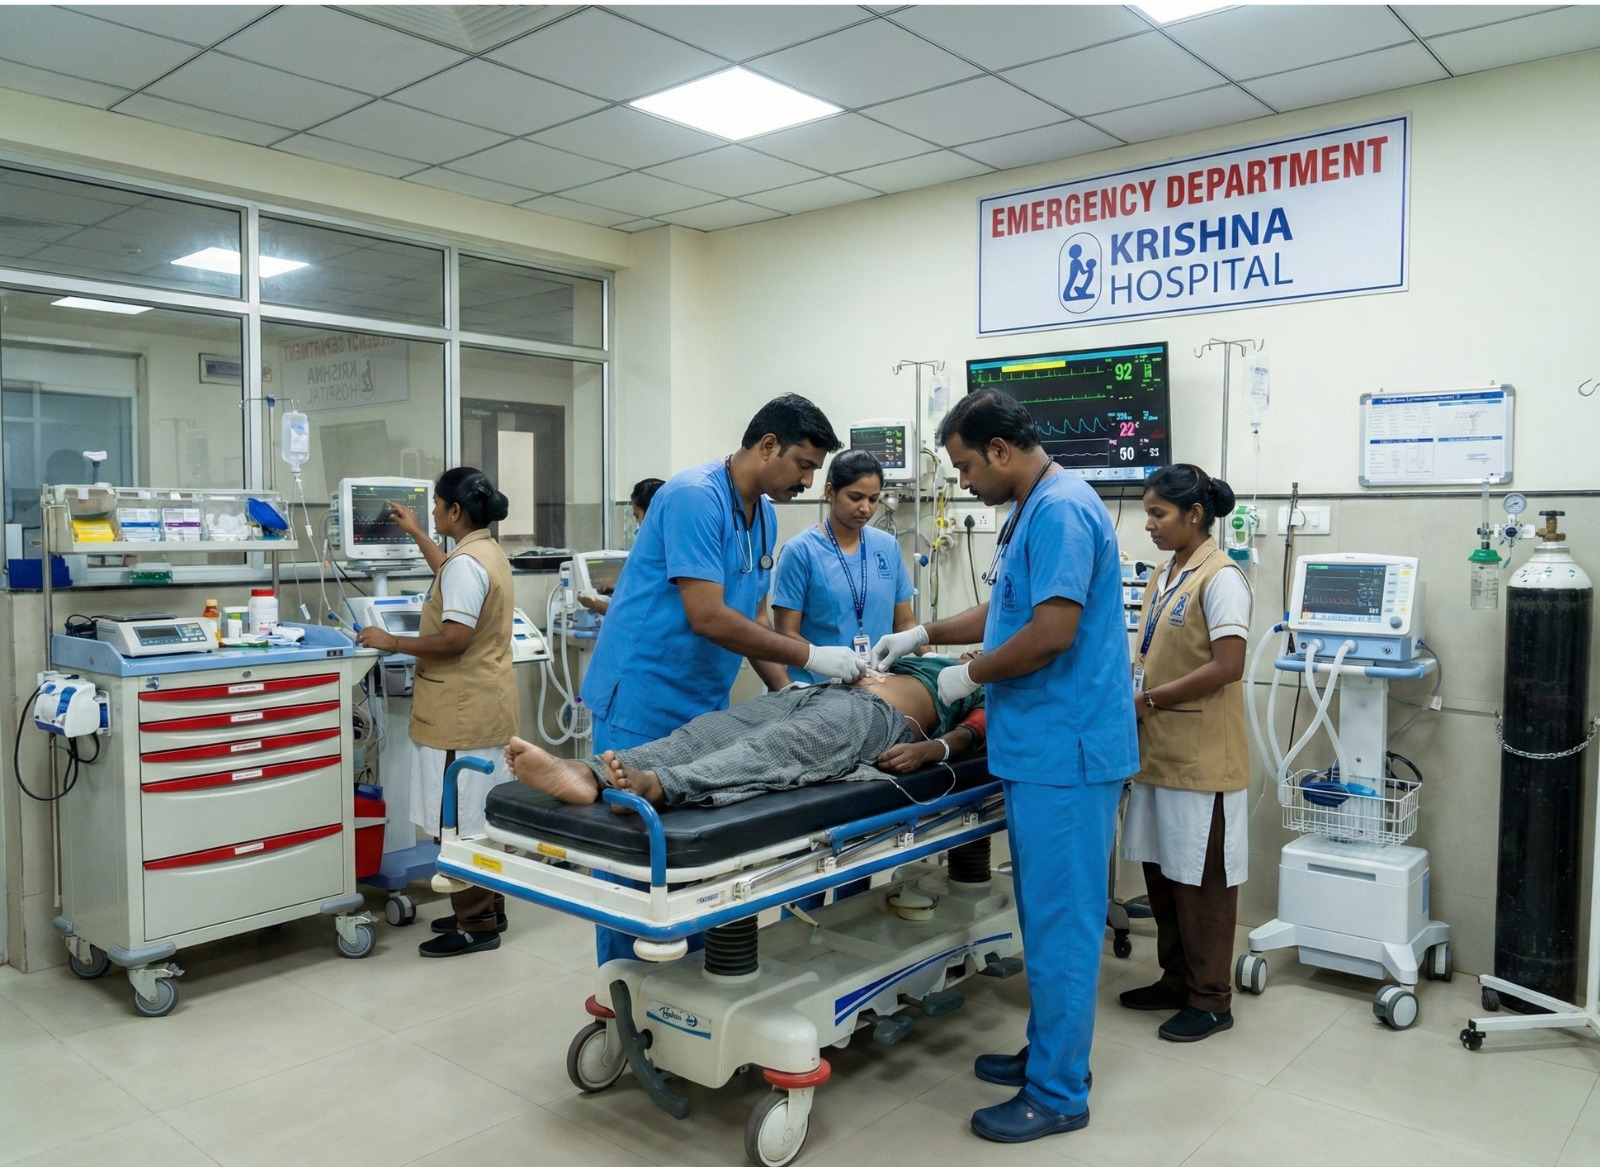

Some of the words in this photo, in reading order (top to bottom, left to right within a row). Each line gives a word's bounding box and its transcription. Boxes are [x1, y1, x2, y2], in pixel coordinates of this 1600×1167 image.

[992, 179, 1157, 238] EMERGENCY
[1166, 136, 1388, 208] DEPARTMENT
[1111, 207, 1293, 266] KRISHNA
[1111, 252, 1293, 305] HOSPITAL
[1115, 362, 1133, 381] 92
[1119, 421, 1135, 437] 22
